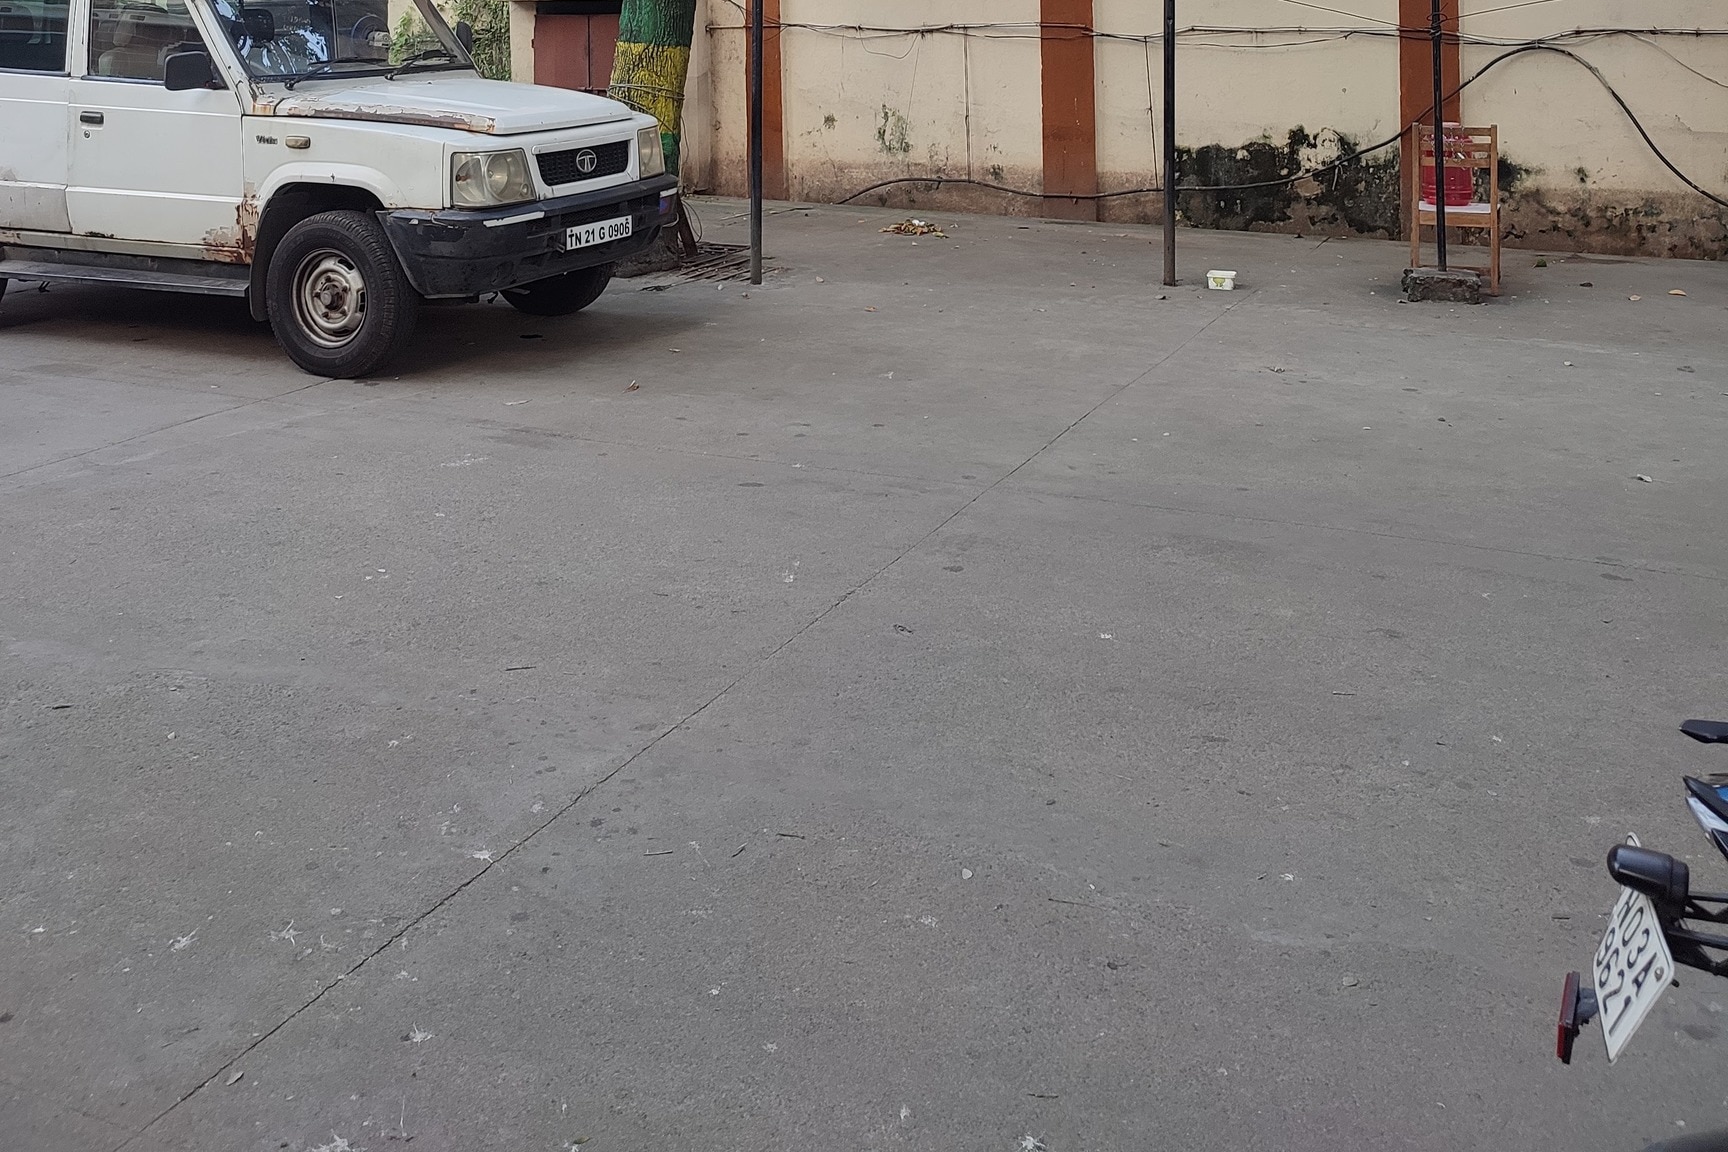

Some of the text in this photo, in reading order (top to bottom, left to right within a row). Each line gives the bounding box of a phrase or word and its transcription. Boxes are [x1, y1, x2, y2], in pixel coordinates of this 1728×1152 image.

[568, 222, 629, 248] TN 21 G 0906
[1597, 927, 1631, 1036] 9621
